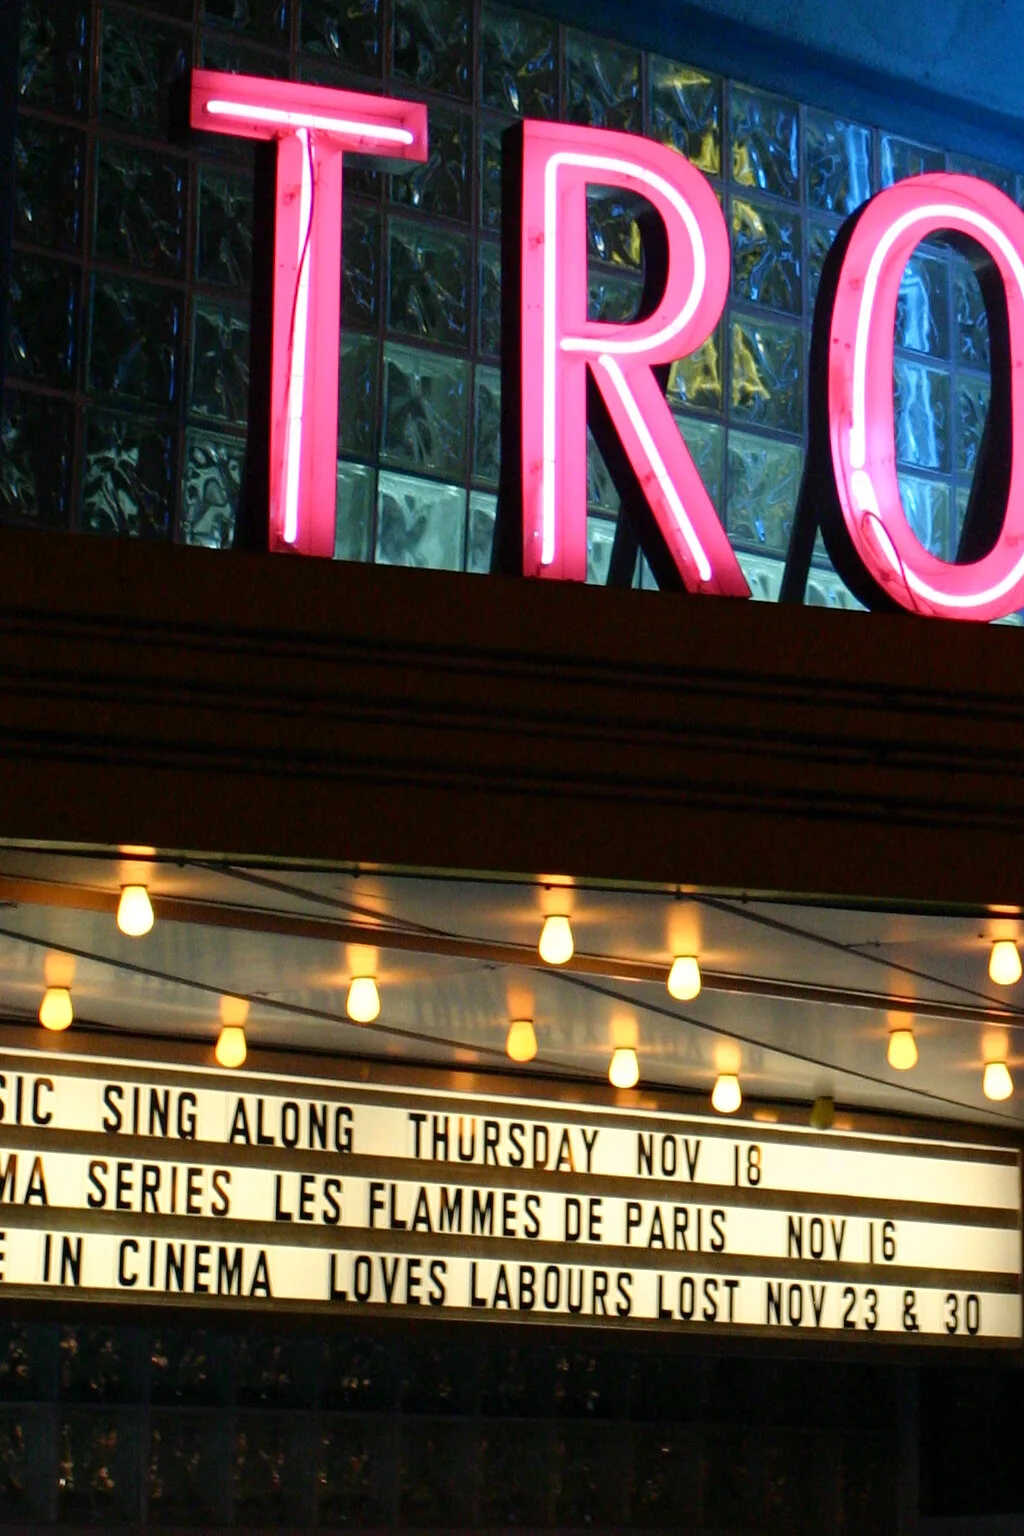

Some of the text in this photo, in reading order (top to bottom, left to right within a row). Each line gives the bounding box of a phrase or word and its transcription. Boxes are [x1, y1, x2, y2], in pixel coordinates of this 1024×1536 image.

[103, 1084, 197, 1140] SING
[230, 1097, 353, 1153] ALONG
[410, 1113, 600, 1172] THURSDAY
[637, 1133, 700, 1183] NOV
[735, 1145, 761, 1186] 18
[87, 1159, 232, 1216] SERIES
[275, 1174, 342, 1224] LES
[369, 1182, 541, 1238] FLAMMES
[565, 1197, 602, 1241] DE
[626, 1202, 727, 1252] PARIS
[788, 1216, 847, 1262] NOV
[869, 1221, 896, 1262] 16
[43, 1233, 84, 1285] IN
[117, 1239, 272, 1297] CINEMA
[329, 1253, 448, 1306] LOVES
[469, 1262, 633, 1317] LABOURS
[657, 1271, 740, 1322] LOST
[766, 1282, 826, 1327] NOV
[843, 1286, 878, 1331] 23
[902, 1291, 921, 1332] &
[945, 1293, 982, 1336] 30
